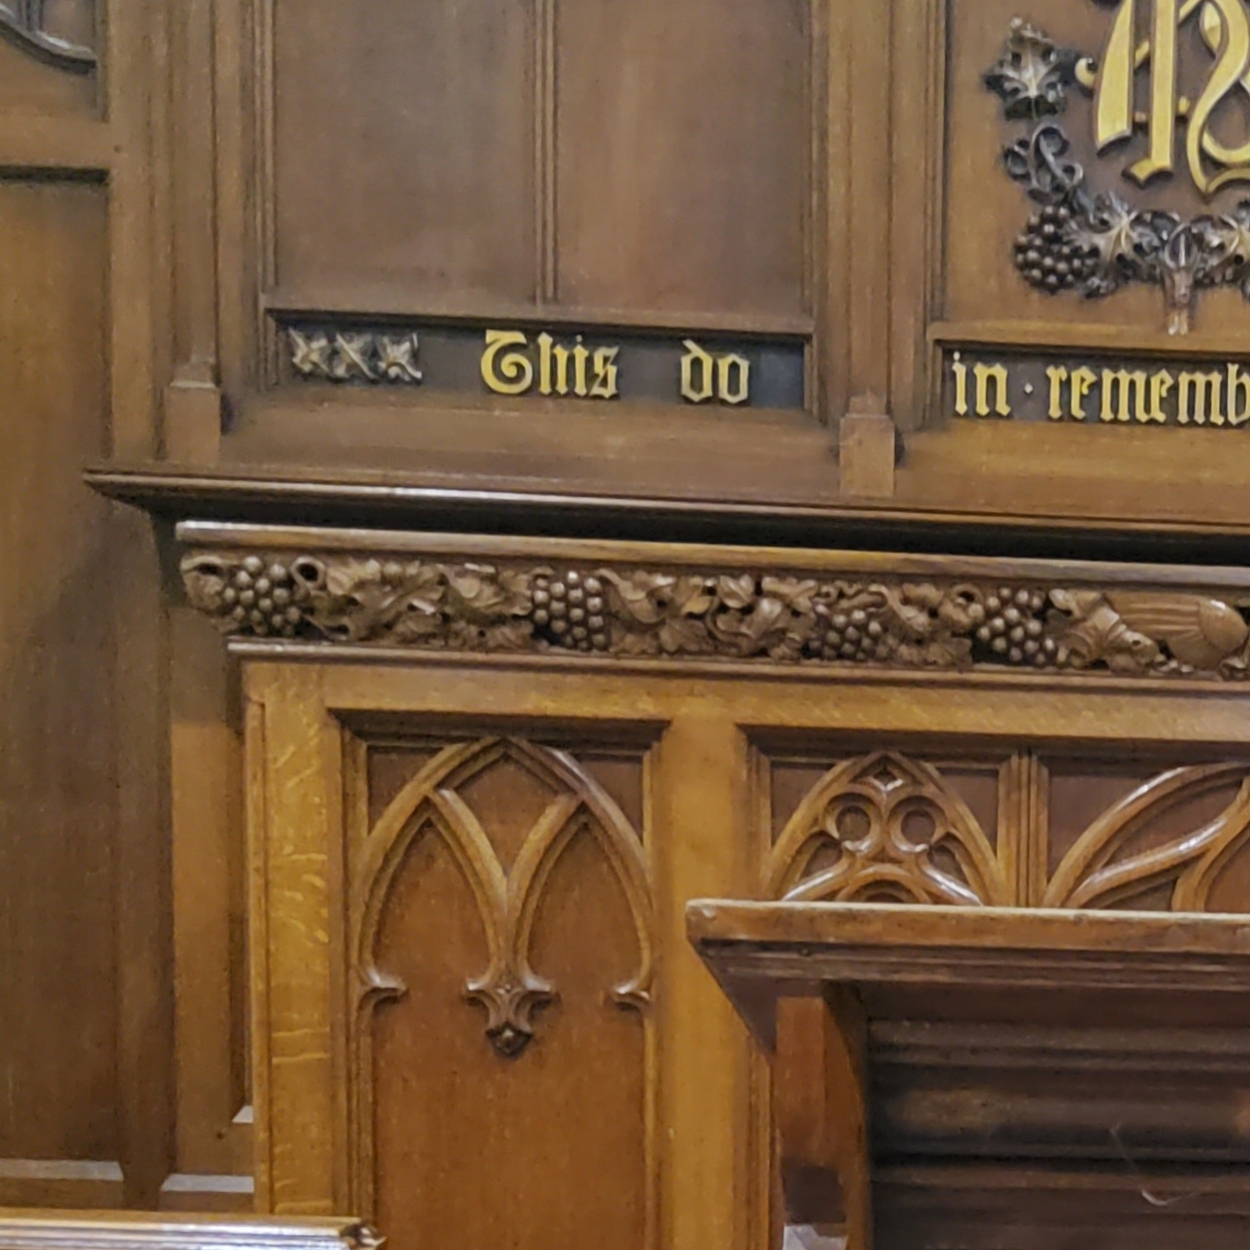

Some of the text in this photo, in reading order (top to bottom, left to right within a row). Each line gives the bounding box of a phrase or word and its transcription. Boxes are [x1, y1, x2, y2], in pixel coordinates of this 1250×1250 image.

[479, 328, 749, 404] This do
[951, 351, 1011, 416] in
